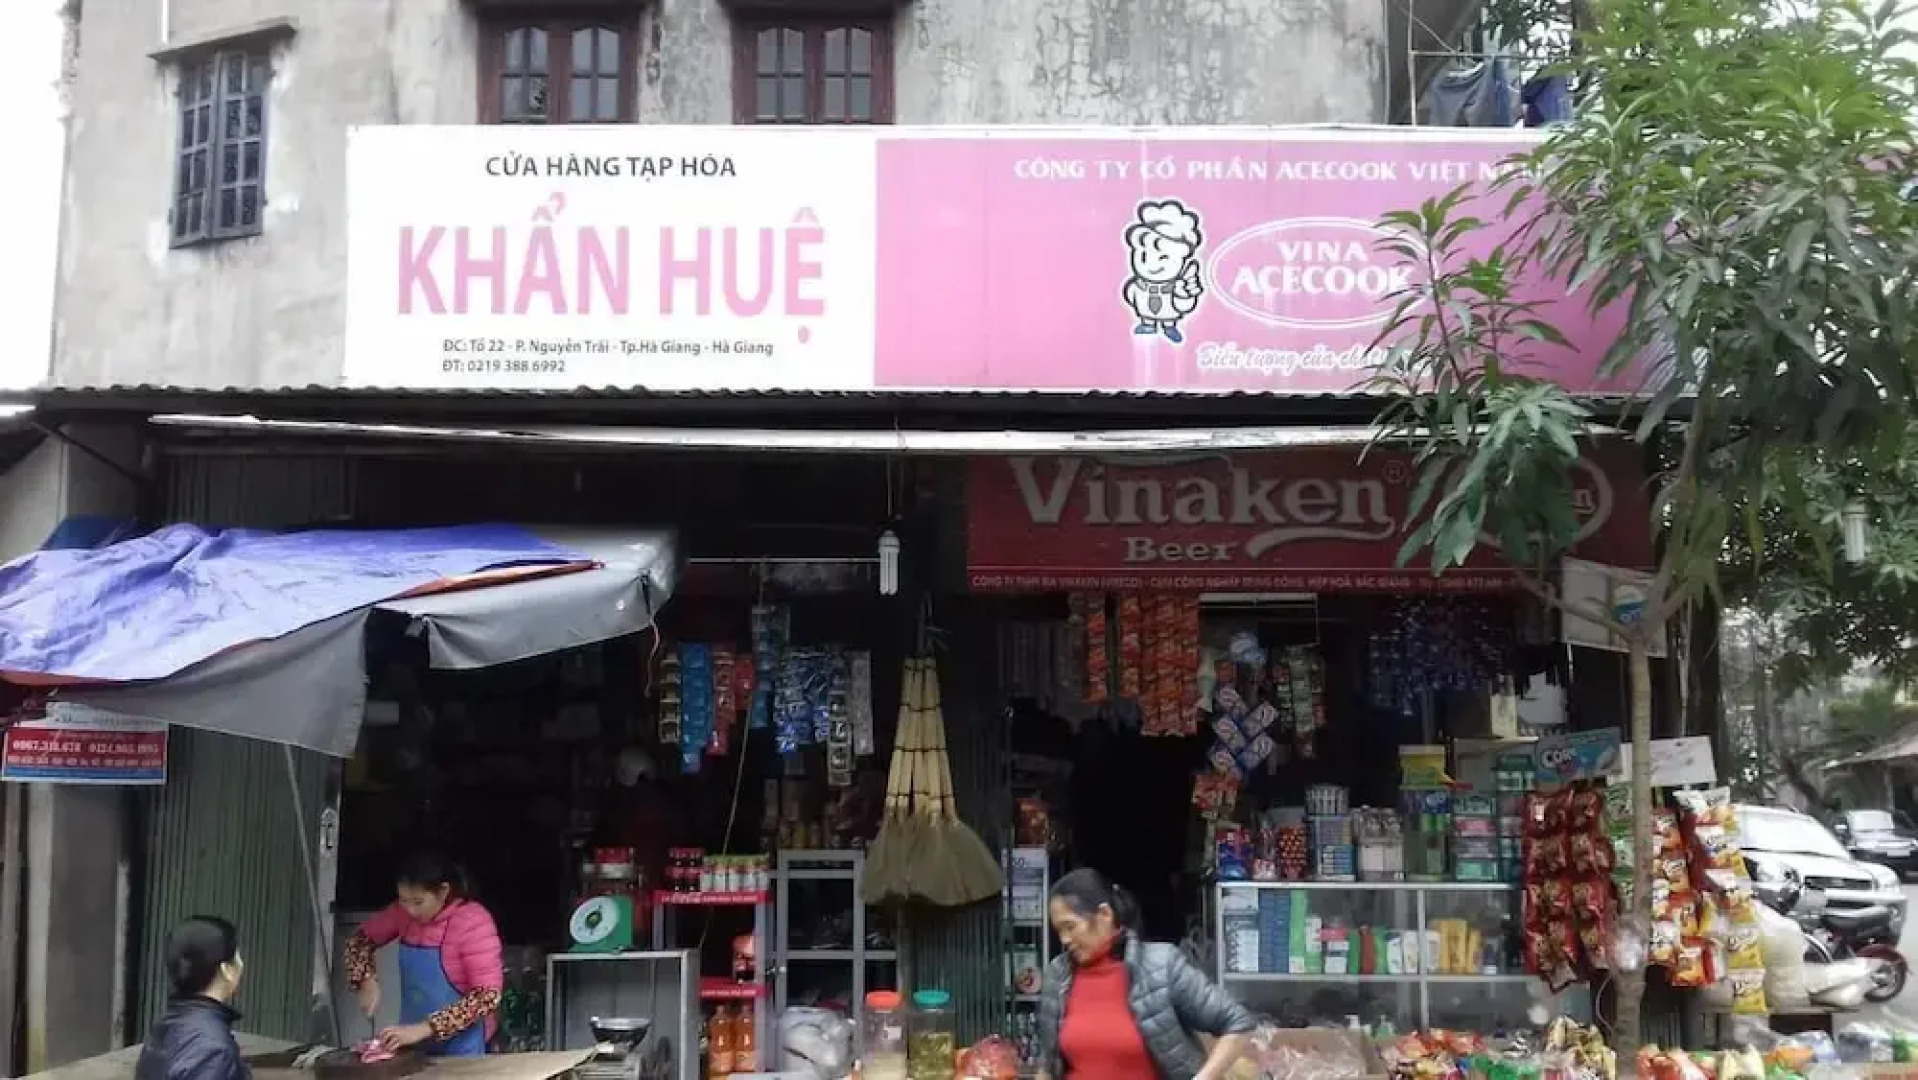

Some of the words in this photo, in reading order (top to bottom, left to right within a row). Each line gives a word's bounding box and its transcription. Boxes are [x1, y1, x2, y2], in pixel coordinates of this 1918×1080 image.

[485, 150, 539, 177] CỬA
[546, 152, 621, 177] HÀNG
[626, 156, 673, 183] TẠP
[680, 153, 737, 177] HÓA
[1013, 155, 1085, 180] CÔNG
[1095, 159, 1131, 180] TY
[1276, 160, 1397, 181] ACECOOK
[1276, 240, 1369, 262] VINA
[397, 191, 631, 316] KHẨN
[659, 206, 826, 344] HUỆ
[1230, 264, 1415, 295] ACECOOK
[487, 340, 505, 354] 22
[515, 340, 527, 354] P.
[661, 340, 701, 357] Giang
[712, 339, 730, 355] Hà
[733, 341, 775, 358] Giang
[467, 359, 501, 373] 0219
[1009, 455, 1395, 525] Vinaken
[1120, 537, 1242, 562] Beer
